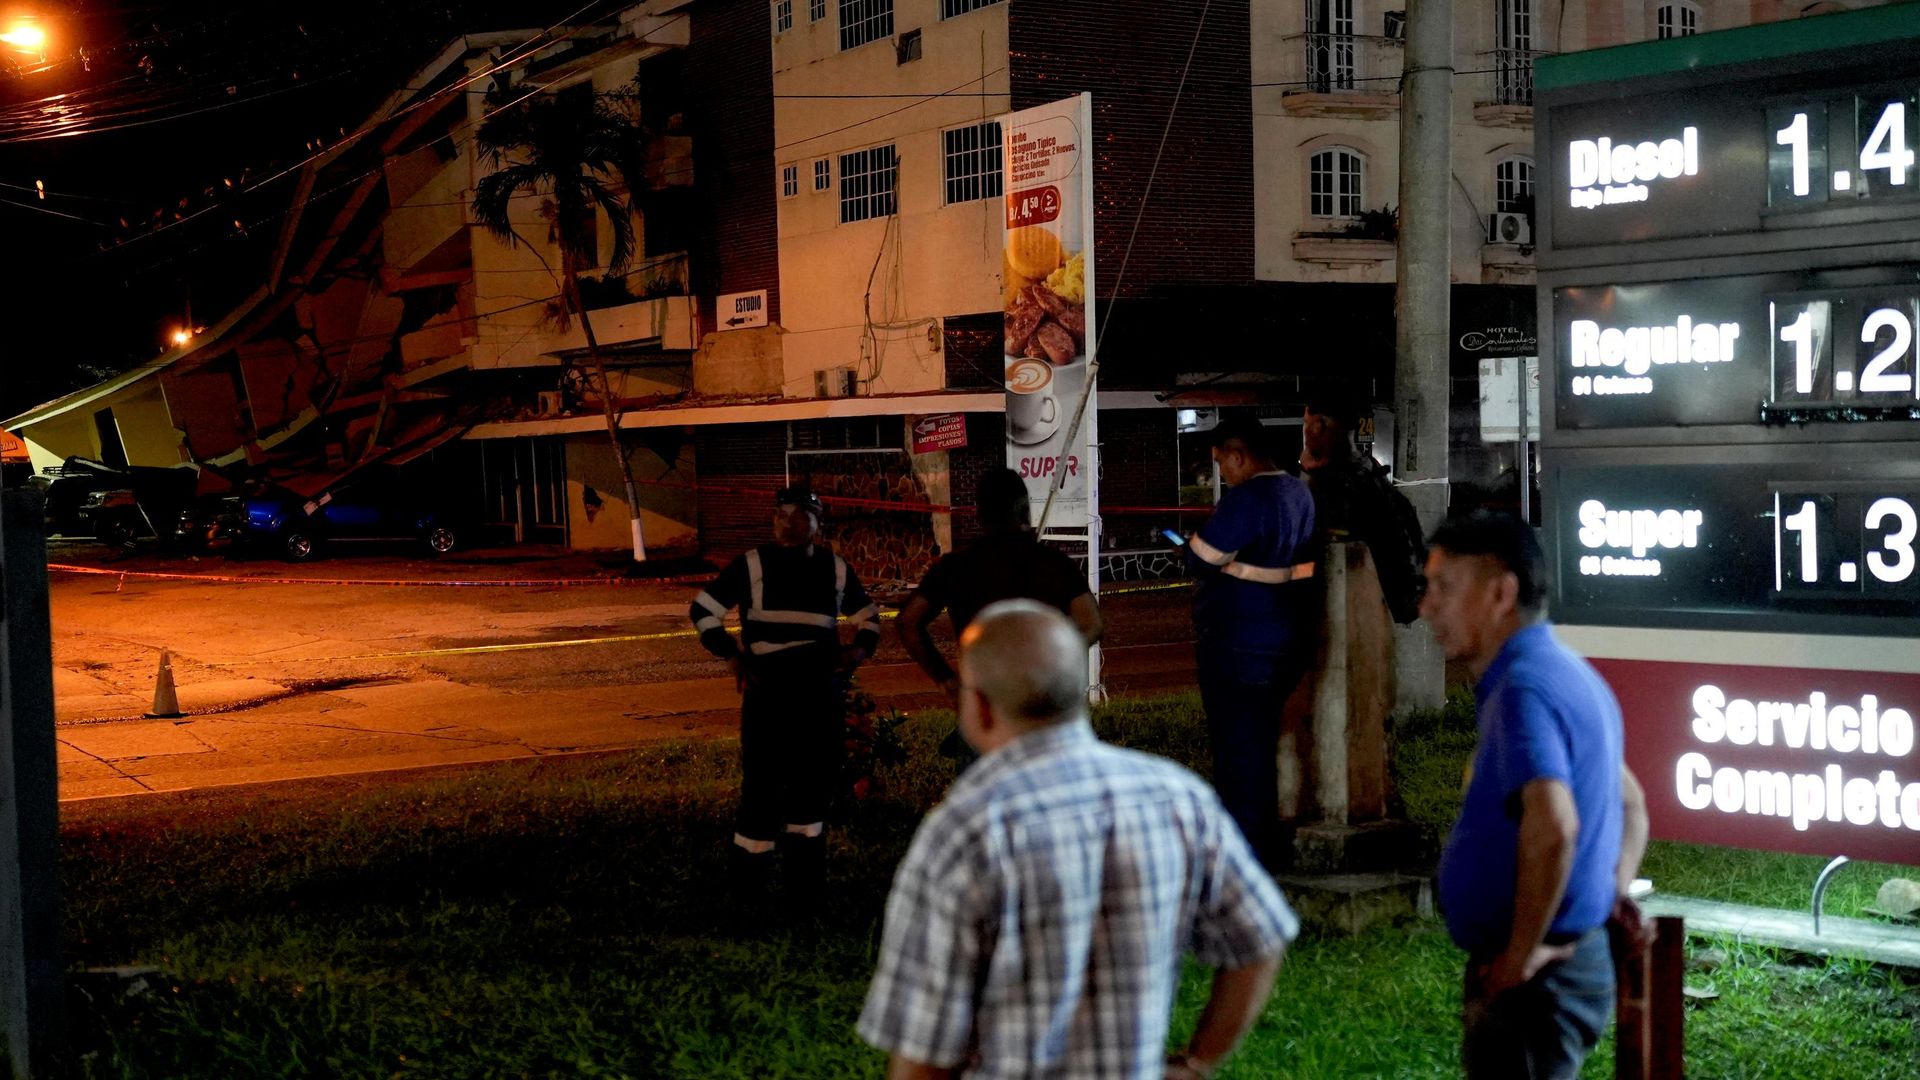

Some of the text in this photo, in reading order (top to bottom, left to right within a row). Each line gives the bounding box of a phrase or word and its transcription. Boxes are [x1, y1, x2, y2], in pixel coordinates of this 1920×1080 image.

[1570, 103, 1914, 195] Diesel 1.4
[736, 295, 762, 313] ESTUDIO
[1571, 309, 1912, 394] Regular 1.2
[918, 431, 961, 444] IMPRESIONES
[938, 423, 961, 433] COPIAS
[1579, 498, 1918, 582] Super 1.3
[1692, 684, 1914, 757] Servicio
